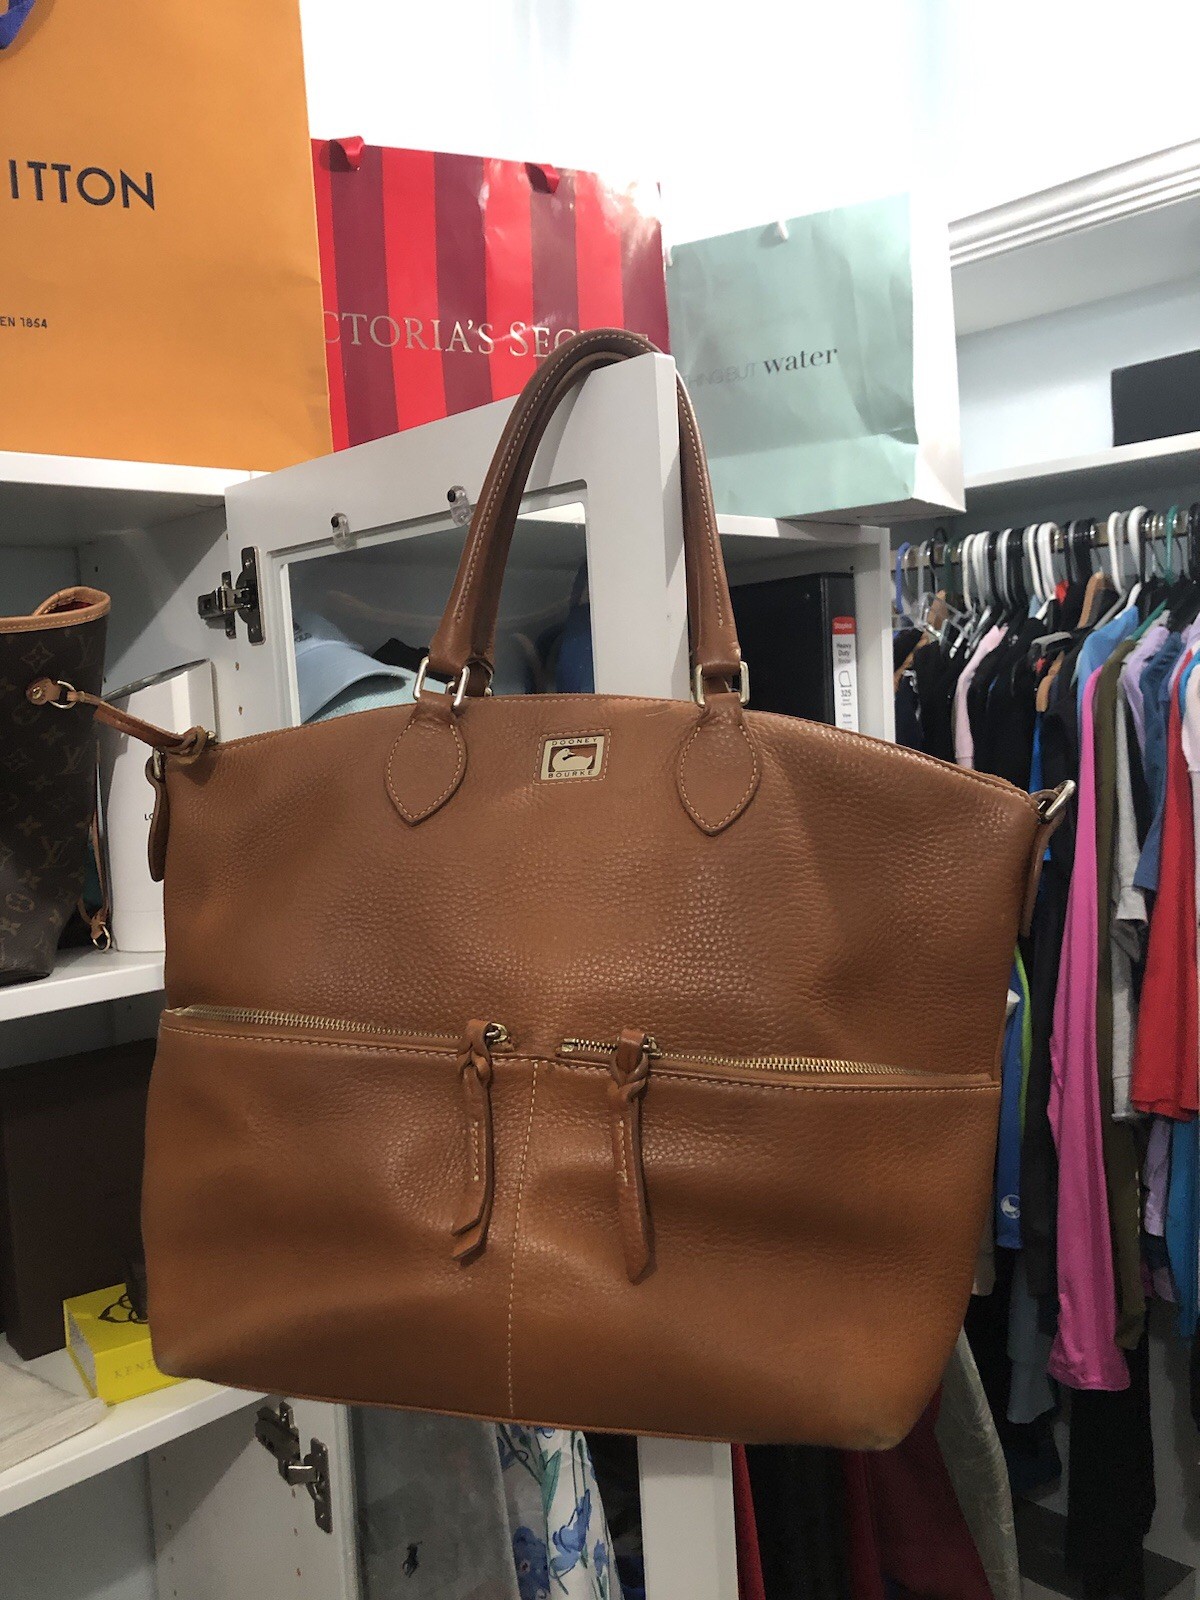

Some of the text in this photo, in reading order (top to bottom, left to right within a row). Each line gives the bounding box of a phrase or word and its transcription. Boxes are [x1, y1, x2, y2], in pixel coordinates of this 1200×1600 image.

[20, 317, 48, 329] 1854
[764, 347, 839, 374] water
[551, 737, 598, 746] DOONEY
[547, 769, 594, 779] BOURKE
